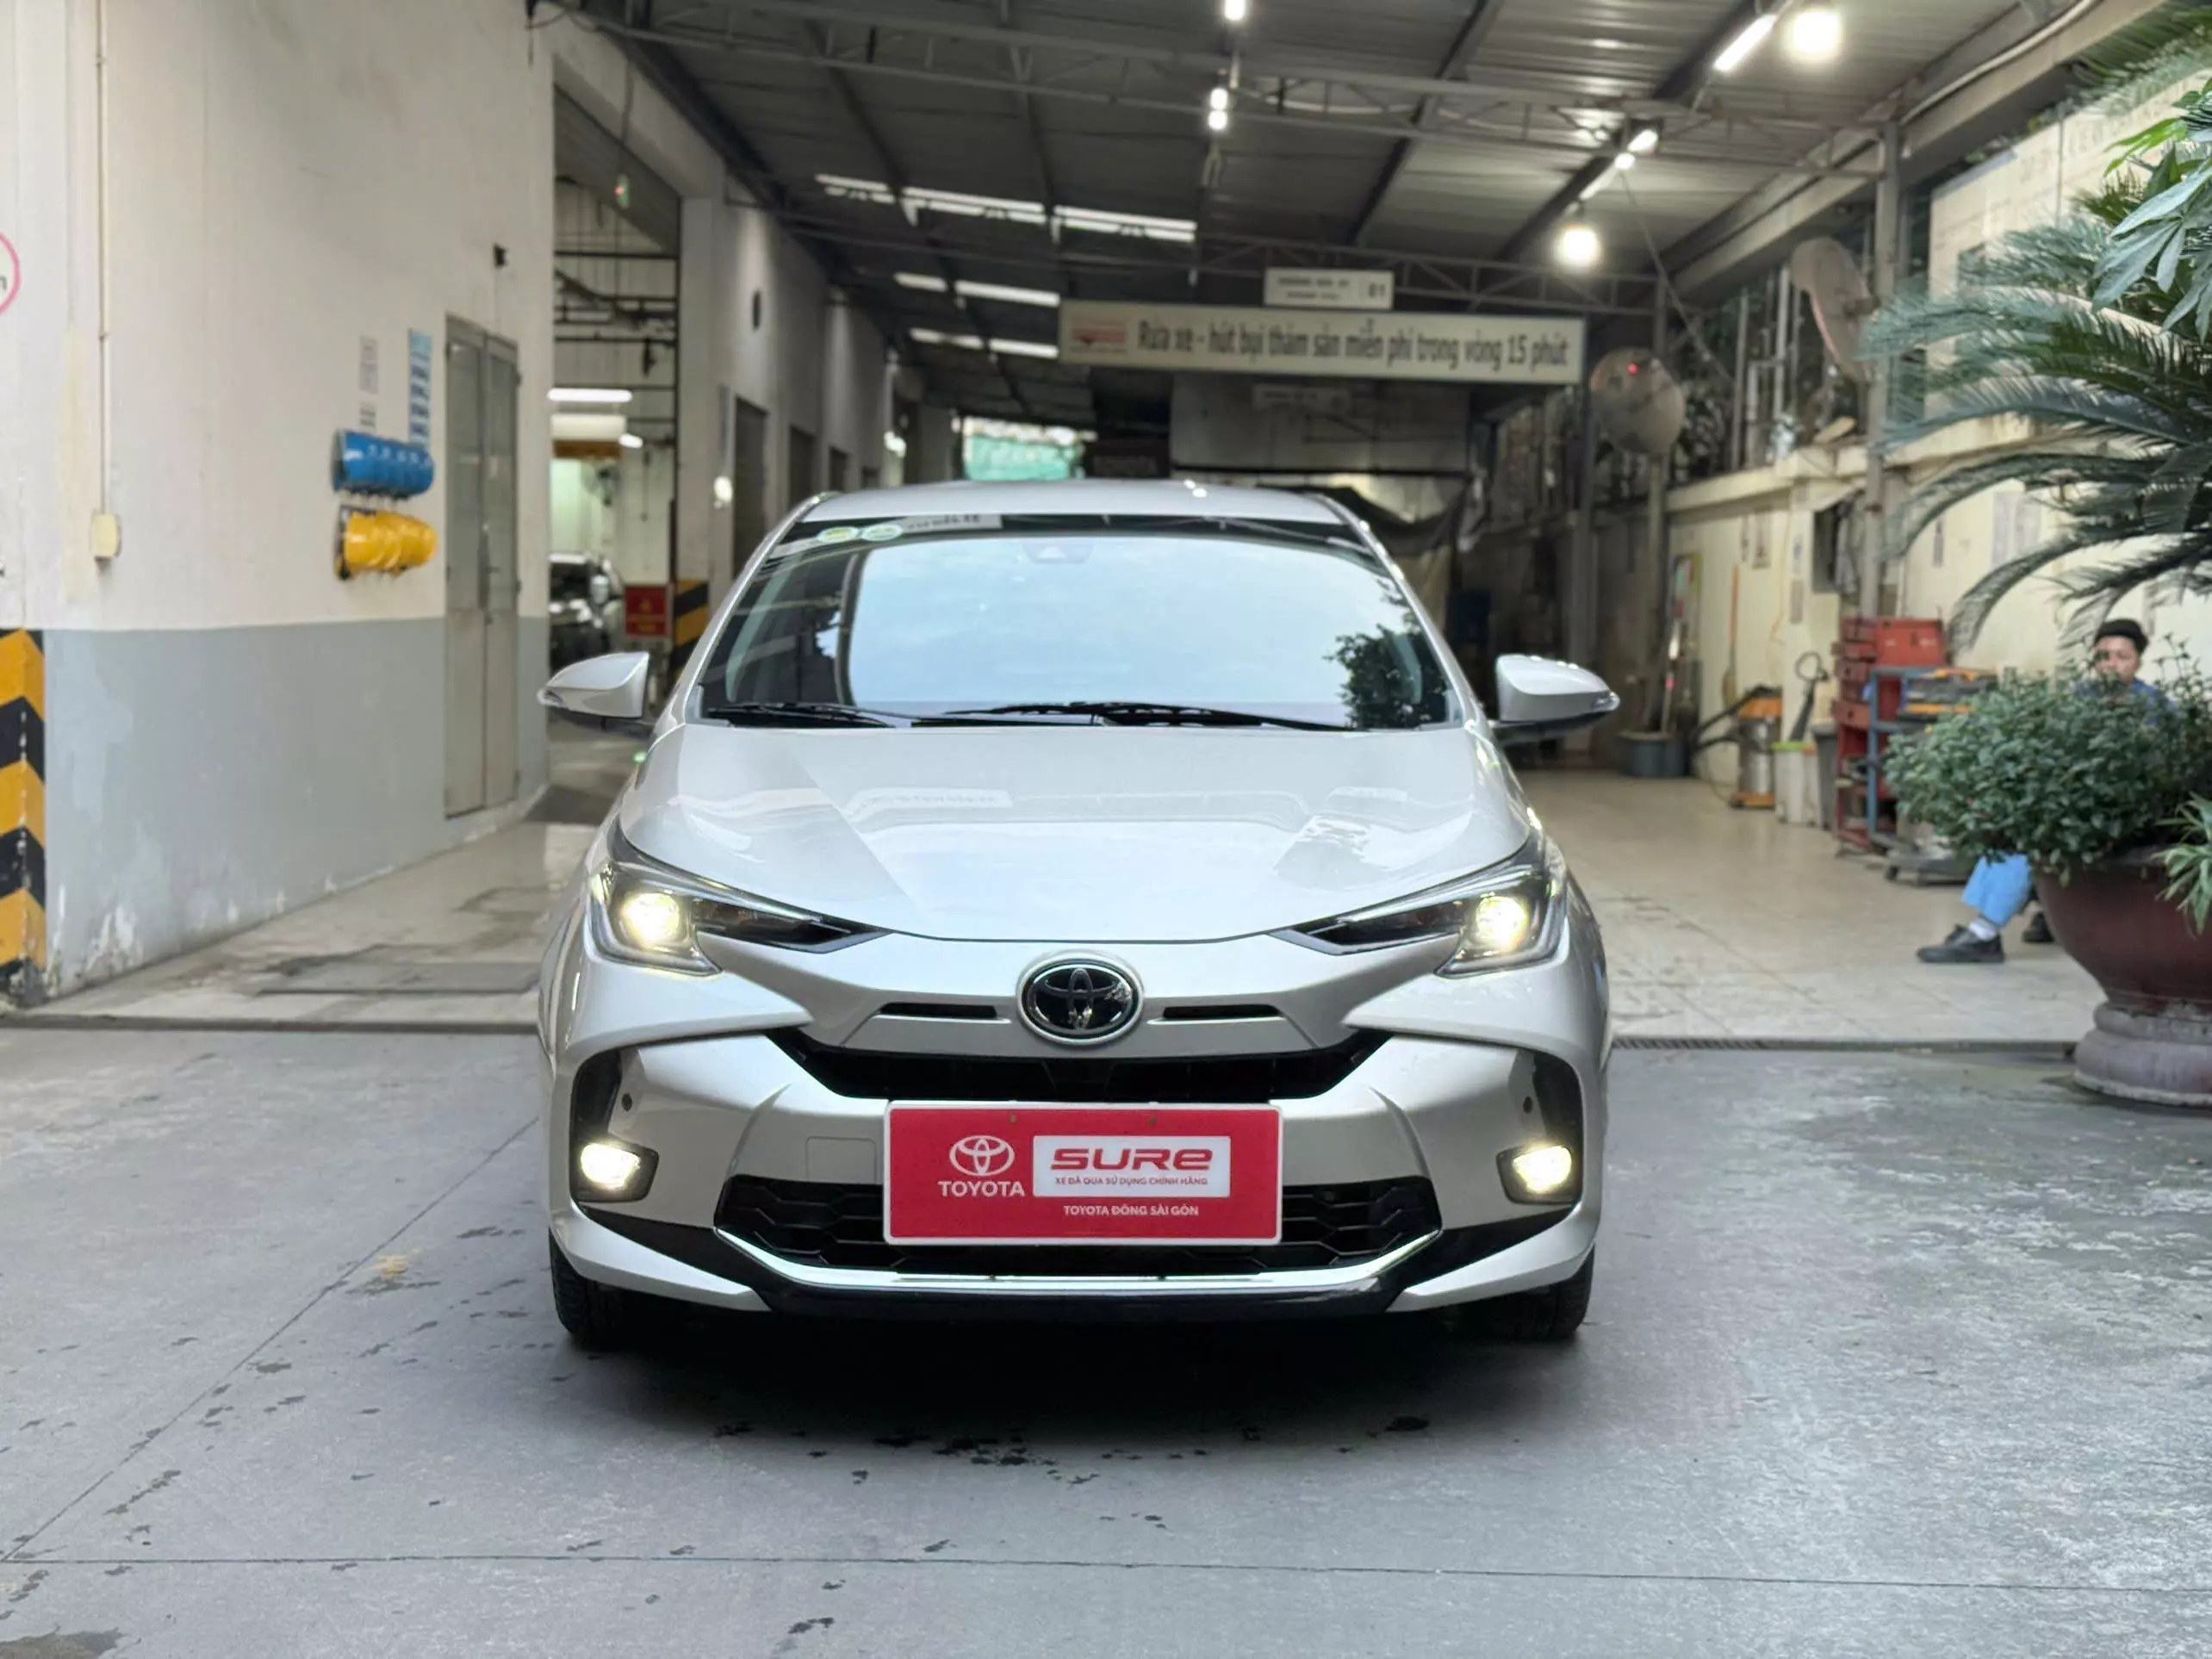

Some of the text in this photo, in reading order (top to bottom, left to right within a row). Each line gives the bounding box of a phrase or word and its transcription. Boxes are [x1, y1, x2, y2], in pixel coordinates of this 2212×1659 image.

[1416, 329, 1459, 370] trong
[1507, 333, 1527, 364] 15
[1531, 332, 1569, 372] phút
[937, 1180, 1026, 1197] TOYOTA
[1055, 1174, 1208, 1188] XE ĐÃ QUA SỬ DỤNG CHÍNH HÃNG
[1064, 1203, 1199, 1216] TOYOTA ĐÔNG SÀI GÒN
